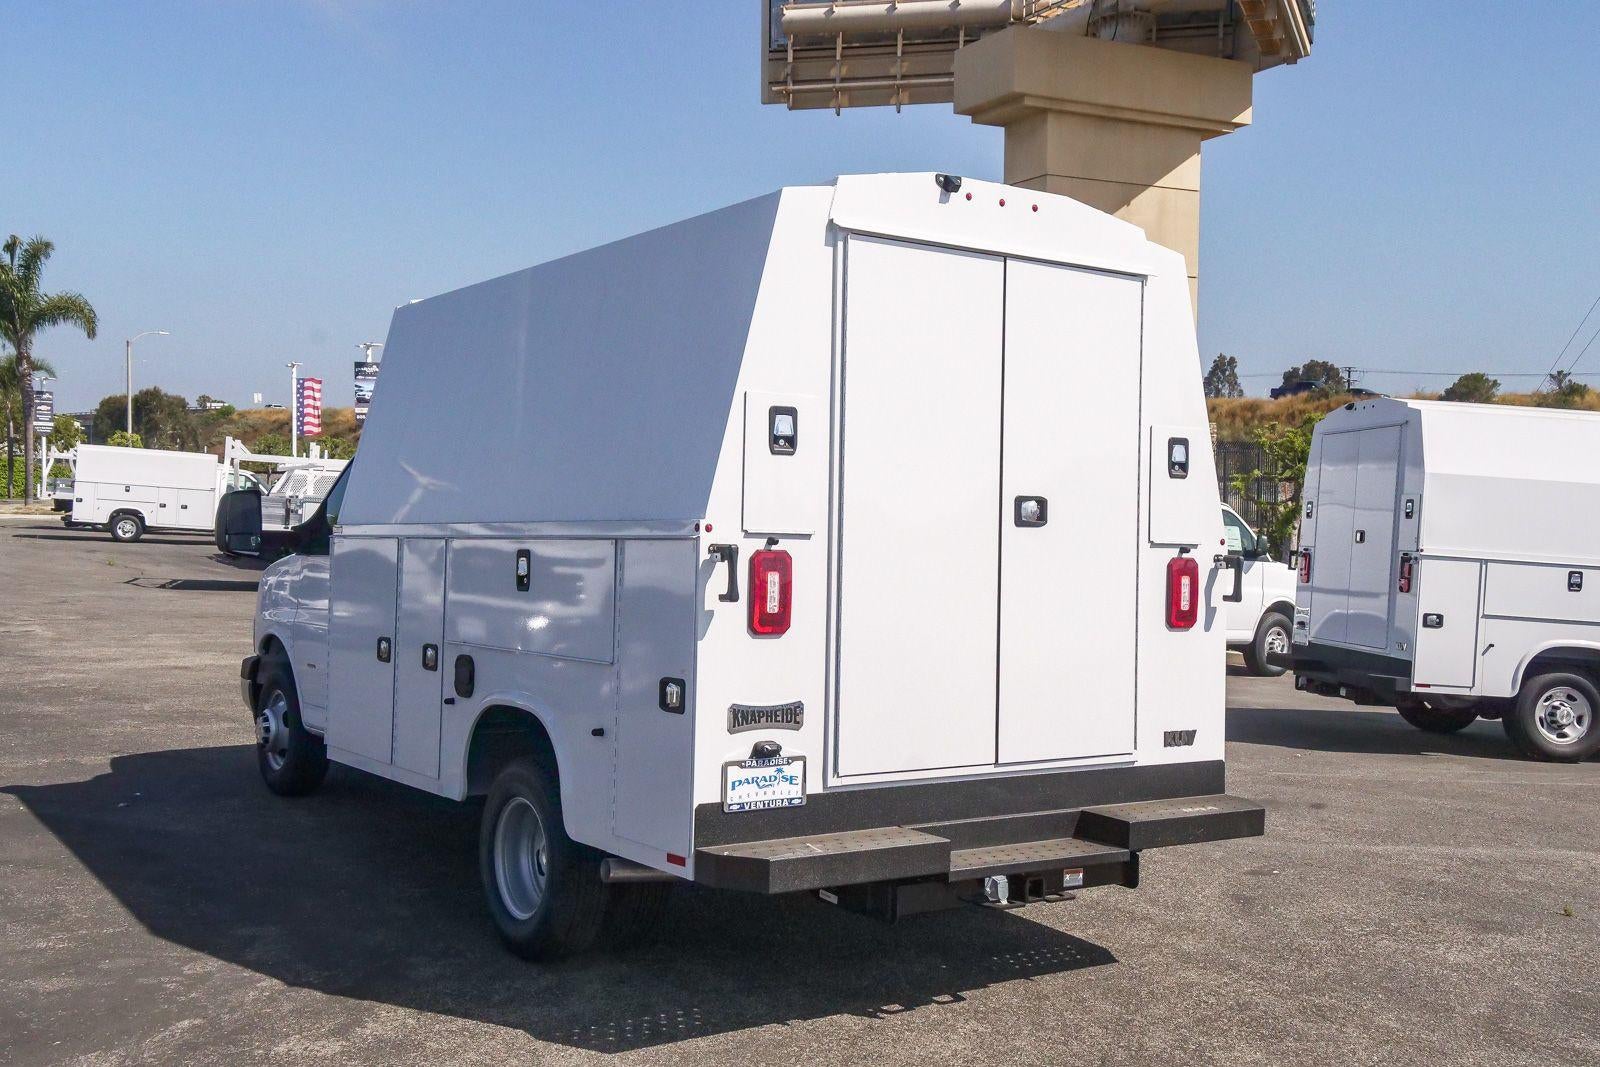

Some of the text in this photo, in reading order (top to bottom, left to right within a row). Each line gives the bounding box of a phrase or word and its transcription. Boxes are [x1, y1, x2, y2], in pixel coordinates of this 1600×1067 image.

[732, 705, 801, 728] KNAPHEIDE
[745, 757, 788, 768] PARADISE
[731, 771, 799, 791] PARADISE
[744, 799, 789, 810] VENTURA
